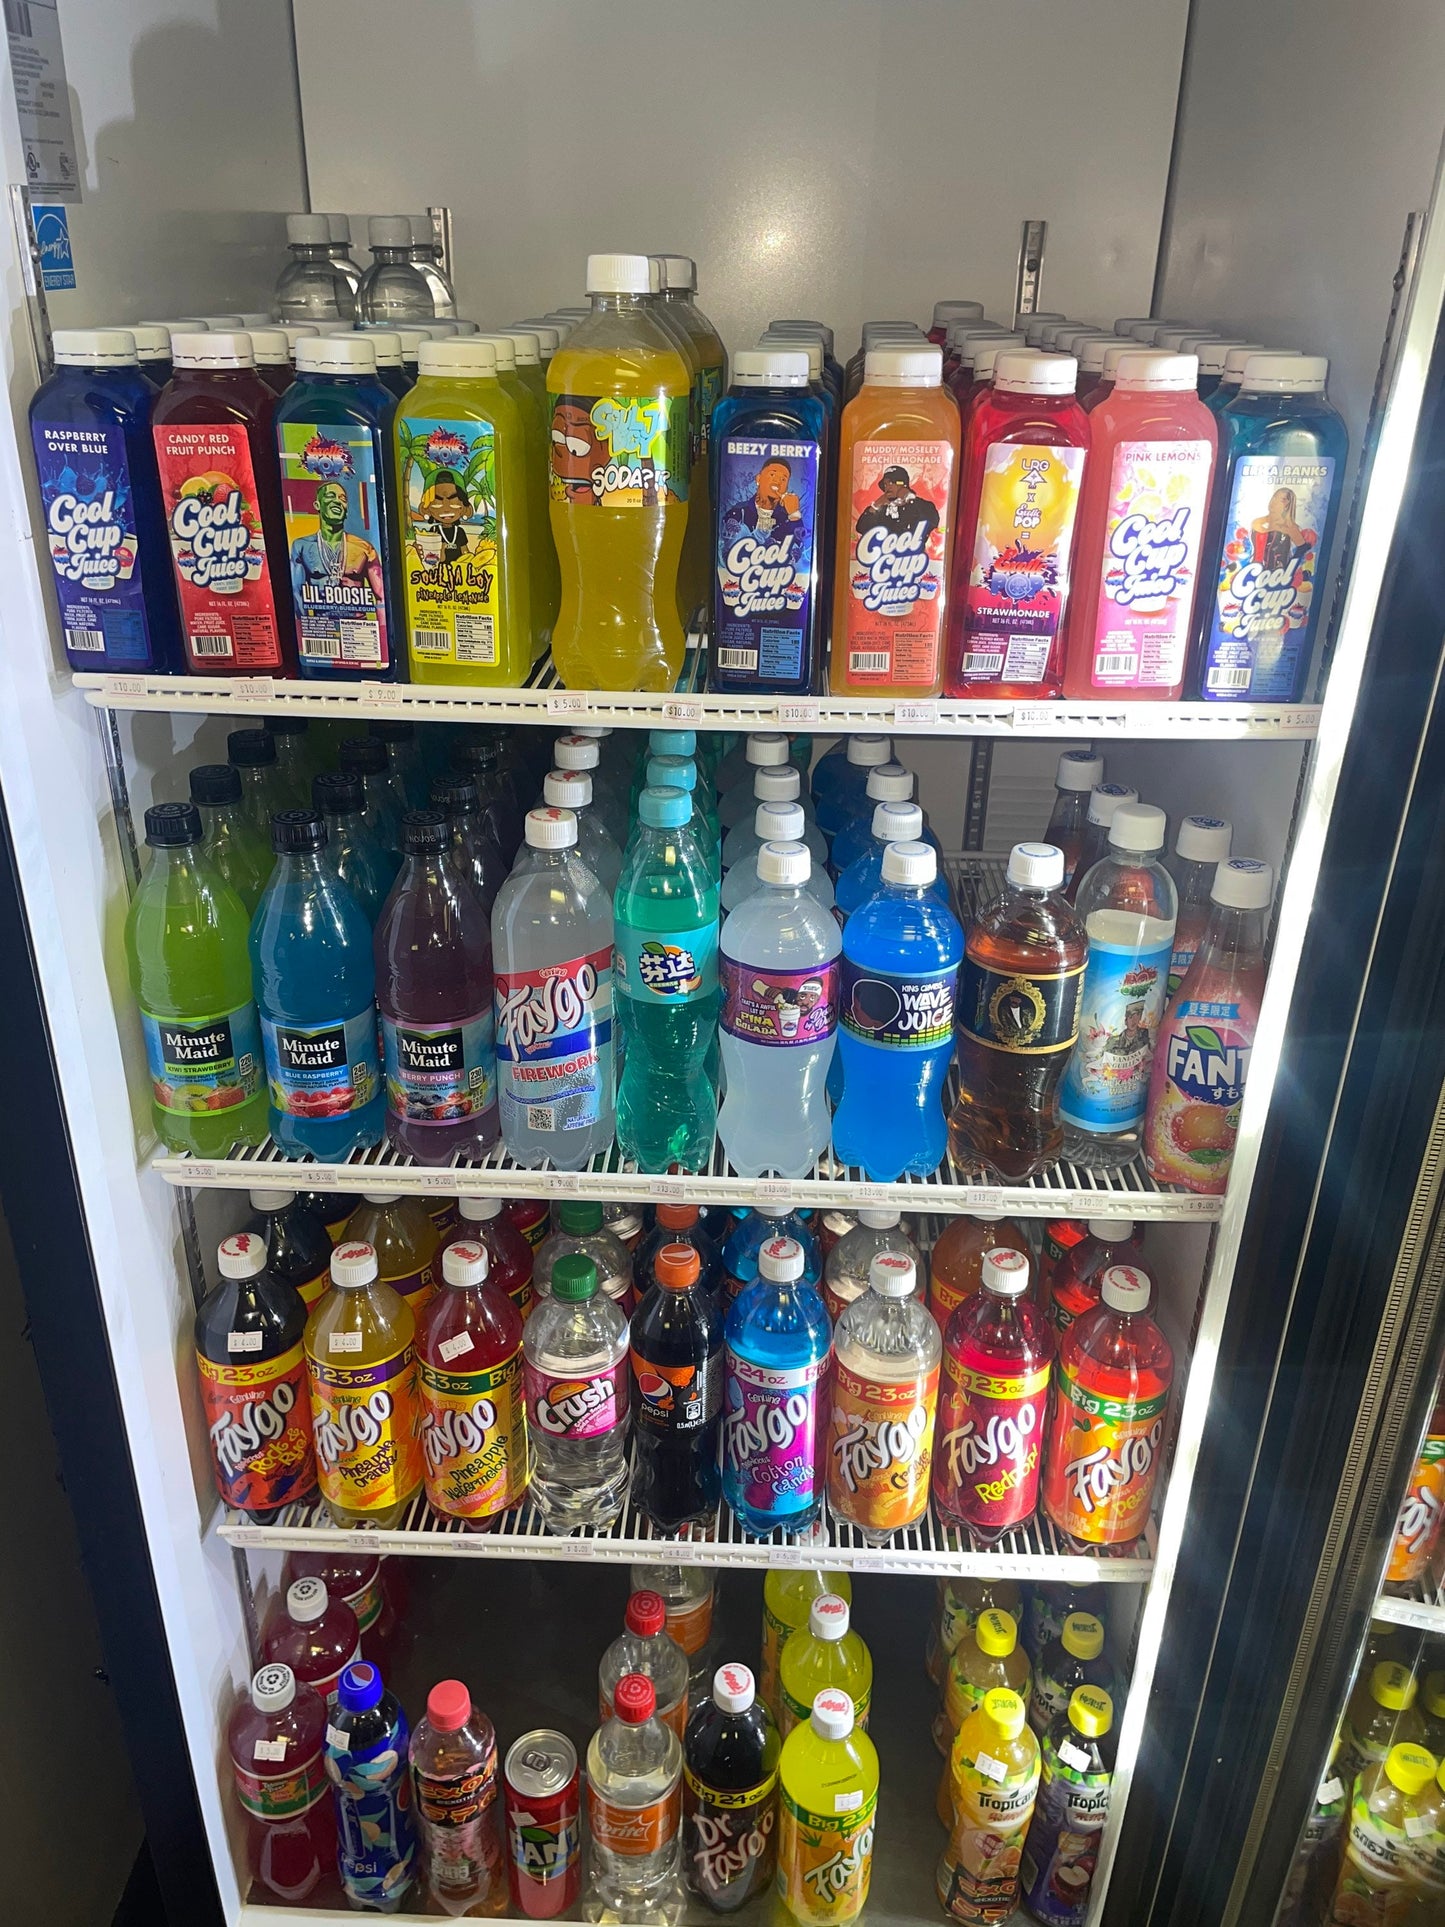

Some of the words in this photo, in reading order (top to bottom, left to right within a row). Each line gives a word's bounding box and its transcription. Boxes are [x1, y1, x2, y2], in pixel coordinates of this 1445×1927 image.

[44, 429, 107, 443] RASPBERRY
[168, 434, 205, 444] CANDY
[209, 434, 230, 444] RED
[48, 442, 77, 453] OVER
[81, 444, 109, 455] BLUE
[166, 446, 196, 456] FRUIT
[197, 446, 236, 456] PUNCH
[727, 442, 768, 456] BEEZY
[770, 443, 813, 458] BERRY
[864, 446, 898, 454] MUDDY
[899, 446, 940, 455] MOSELEY
[1125, 452, 1152, 462] PINK
[861, 455, 891, 464] PEACH
[892, 455, 942, 465] LEMONADE
[1021, 458, 1050, 471] LRG
[1282, 465, 1328, 477] BANKS
[1026, 492, 1036, 503] X
[50, 491, 114, 534] Cool
[174, 491, 241, 538] Cool
[1013, 514, 1042, 529] POP
[67, 523, 122, 555] Cup
[193, 527, 248, 559] Cup
[857, 520, 928, 565] Cool
[728, 534, 794, 572] Cool
[66, 552, 119, 581] Juice
[193, 555, 246, 585] Juice
[870, 552, 927, 584] Cup
[740, 565, 795, 595] Cup
[1231, 558, 1299, 600] Cool
[302, 585, 323, 604] LIL
[325, 586, 374, 606] BOOSIE
[734, 591, 785, 618] Juice
[864, 581, 919, 610] Juice
[1241, 587, 1297, 616] Cup
[977, 607, 1050, 618] STRAWMONADE
[1233, 613, 1285, 640] Juice
[239, 684, 268, 695] $10.00
[377, 689, 397, 700] 9.00
[553, 699, 559, 708] $
[562, 698, 582, 709] 5.00
[668, 706, 696, 718] $10.00
[784, 707, 813, 719] $10.00
[1286, 715, 1292, 724] $
[1295, 714, 1316, 724] 5.00
[640, 951, 695, 983] 芬达
[901, 985, 919, 993] KING
[902, 986, 951, 1011] WAVE
[500, 963, 599, 1062] Faygo
[741, 998, 755, 1007] THAT'S
[760, 1003, 777, 1011] AWFUL
[1188, 1002, 1231, 1017] 夏季限定
[735, 1017, 778, 1036] COLADA
[898, 1002, 953, 1031] JUICE
[165, 1031, 226, 1048] Minute
[281, 1037, 340, 1052] Minute
[401, 1039, 458, 1055] Minute
[175, 1044, 220, 1060] Maid
[291, 1051, 334, 1066] Maid
[409, 1054, 451, 1067] Maid
[1168, 1036, 1252, 1087] FANT
[183, 1061, 232, 1073] STRAWBERRY
[302, 1070, 343, 1079] RASPBERRY
[402, 1073, 428, 1082] BERRY
[429, 1073, 461, 1082] PUNCH
[187, 1168, 193, 1176] $
[196, 1166, 212, 1177] 5.00
[307, 1172, 314, 1181] $
[315, 1172, 333, 1183] 5.00
[427, 1176, 433, 1185] $
[436, 1176, 452, 1185] 5.00
[548, 1178, 555, 1188] $
[556, 1178, 574, 1188] 9.00
[233, 1338, 238, 1347] $
[241, 1337, 257, 1347] 4.00
[222, 1367, 255, 1382] 23
[256, 1367, 278, 1379] oz.
[322, 1368, 353, 1385] 23
[354, 1372, 376, 1384] oz.
[425, 1373, 451, 1390] 23
[451, 1381, 472, 1391] oz.
[489, 1364, 516, 1387] Big
[739, 1363, 767, 1383] 24
[767, 1374, 789, 1385] oz.
[804, 1360, 831, 1382] Big
[949, 1361, 973, 1389] Big
[975, 1377, 1008, 1395] 23
[837, 1368, 862, 1396] Big
[865, 1386, 898, 1402] 23
[229, 1390, 266, 1404] Genuine
[536, 1377, 616, 1434] Crush
[747, 1393, 781, 1405] Genuine
[1069, 1384, 1100, 1415] Big
[1103, 1403, 1137, 1419] 23
[641, 1402, 669, 1418] pepsi
[210, 1382, 295, 1477] Faygo
[313, 1389, 394, 1472] Faygo
[421, 1398, 497, 1478] Faygo
[725, 1394, 809, 1472] Faygo
[248, 1438, 289, 1475] Rock
[833, 1405, 928, 1494] Faygo
[941, 1403, 1036, 1488] Faygo
[339, 1439, 396, 1481] Pineapple
[449, 1434, 508, 1485] Pineapple
[752, 1455, 803, 1484] Cotton
[1064, 1418, 1162, 1513] Faygo
[442, 1449, 510, 1501] Watermelon!
[771, 1464, 815, 1496] Candy
[974, 1442, 1039, 1505] Redpop!
[690, 1777, 716, 1806] Big
[718, 1791, 748, 1805] 24
[1066, 1790, 1109, 1813] Tropic
[595, 1814, 646, 1838] Sprite
[692, 1811, 731, 1843] Dr
[808, 1814, 839, 1833] Big
[509, 1820, 579, 1865] FANT
[693, 1810, 775, 1891] Faygo
[345, 1857, 378, 1873] epsi
